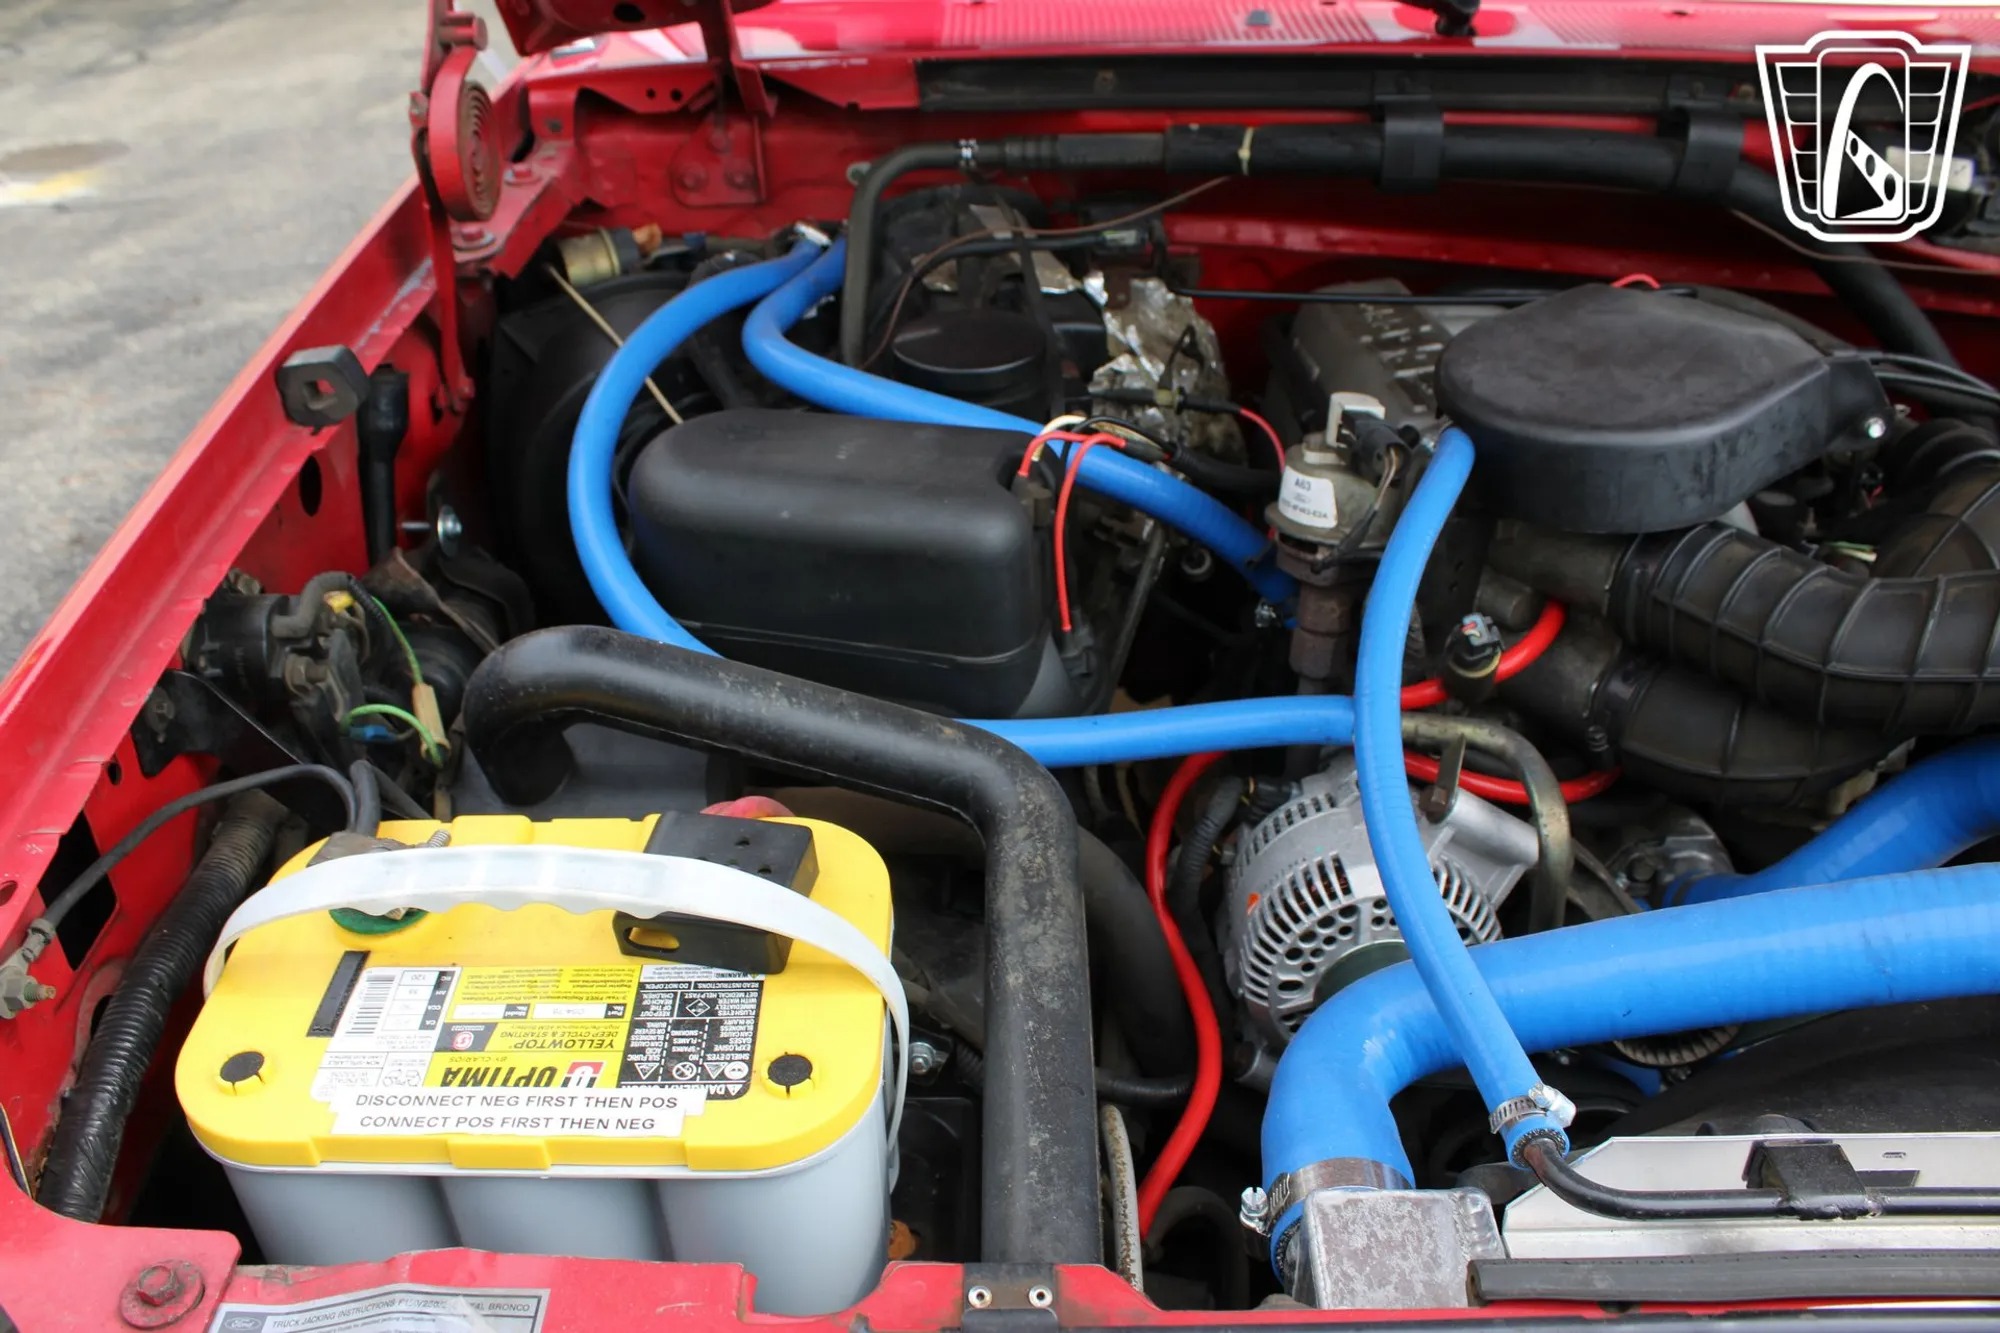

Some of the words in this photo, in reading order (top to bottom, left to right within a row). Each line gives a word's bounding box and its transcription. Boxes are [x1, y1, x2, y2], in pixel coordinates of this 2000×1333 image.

[713, 1044, 751, 1052] EXPLOSIVE
[356, 1094, 476, 1107] DISCONNECT
[480, 1095, 520, 1107] NEG
[525, 1095, 579, 1107] FIRST
[584, 1096, 634, 1108] THEN
[639, 1097, 678, 1109] POS
[360, 1115, 451, 1128] CONNECT
[455, 1116, 495, 1128] POS
[500, 1117, 554, 1129] FIRST
[560, 1117, 610, 1129] THEN
[615, 1118, 656, 1130] NEG
[272, 1318, 300, 1329] TRUCK
[302, 1312, 336, 1325] JACKING
[337, 1299, 396, 1318] INSTRUCTIONS
[488, 1303, 531, 1312] BRONCO
